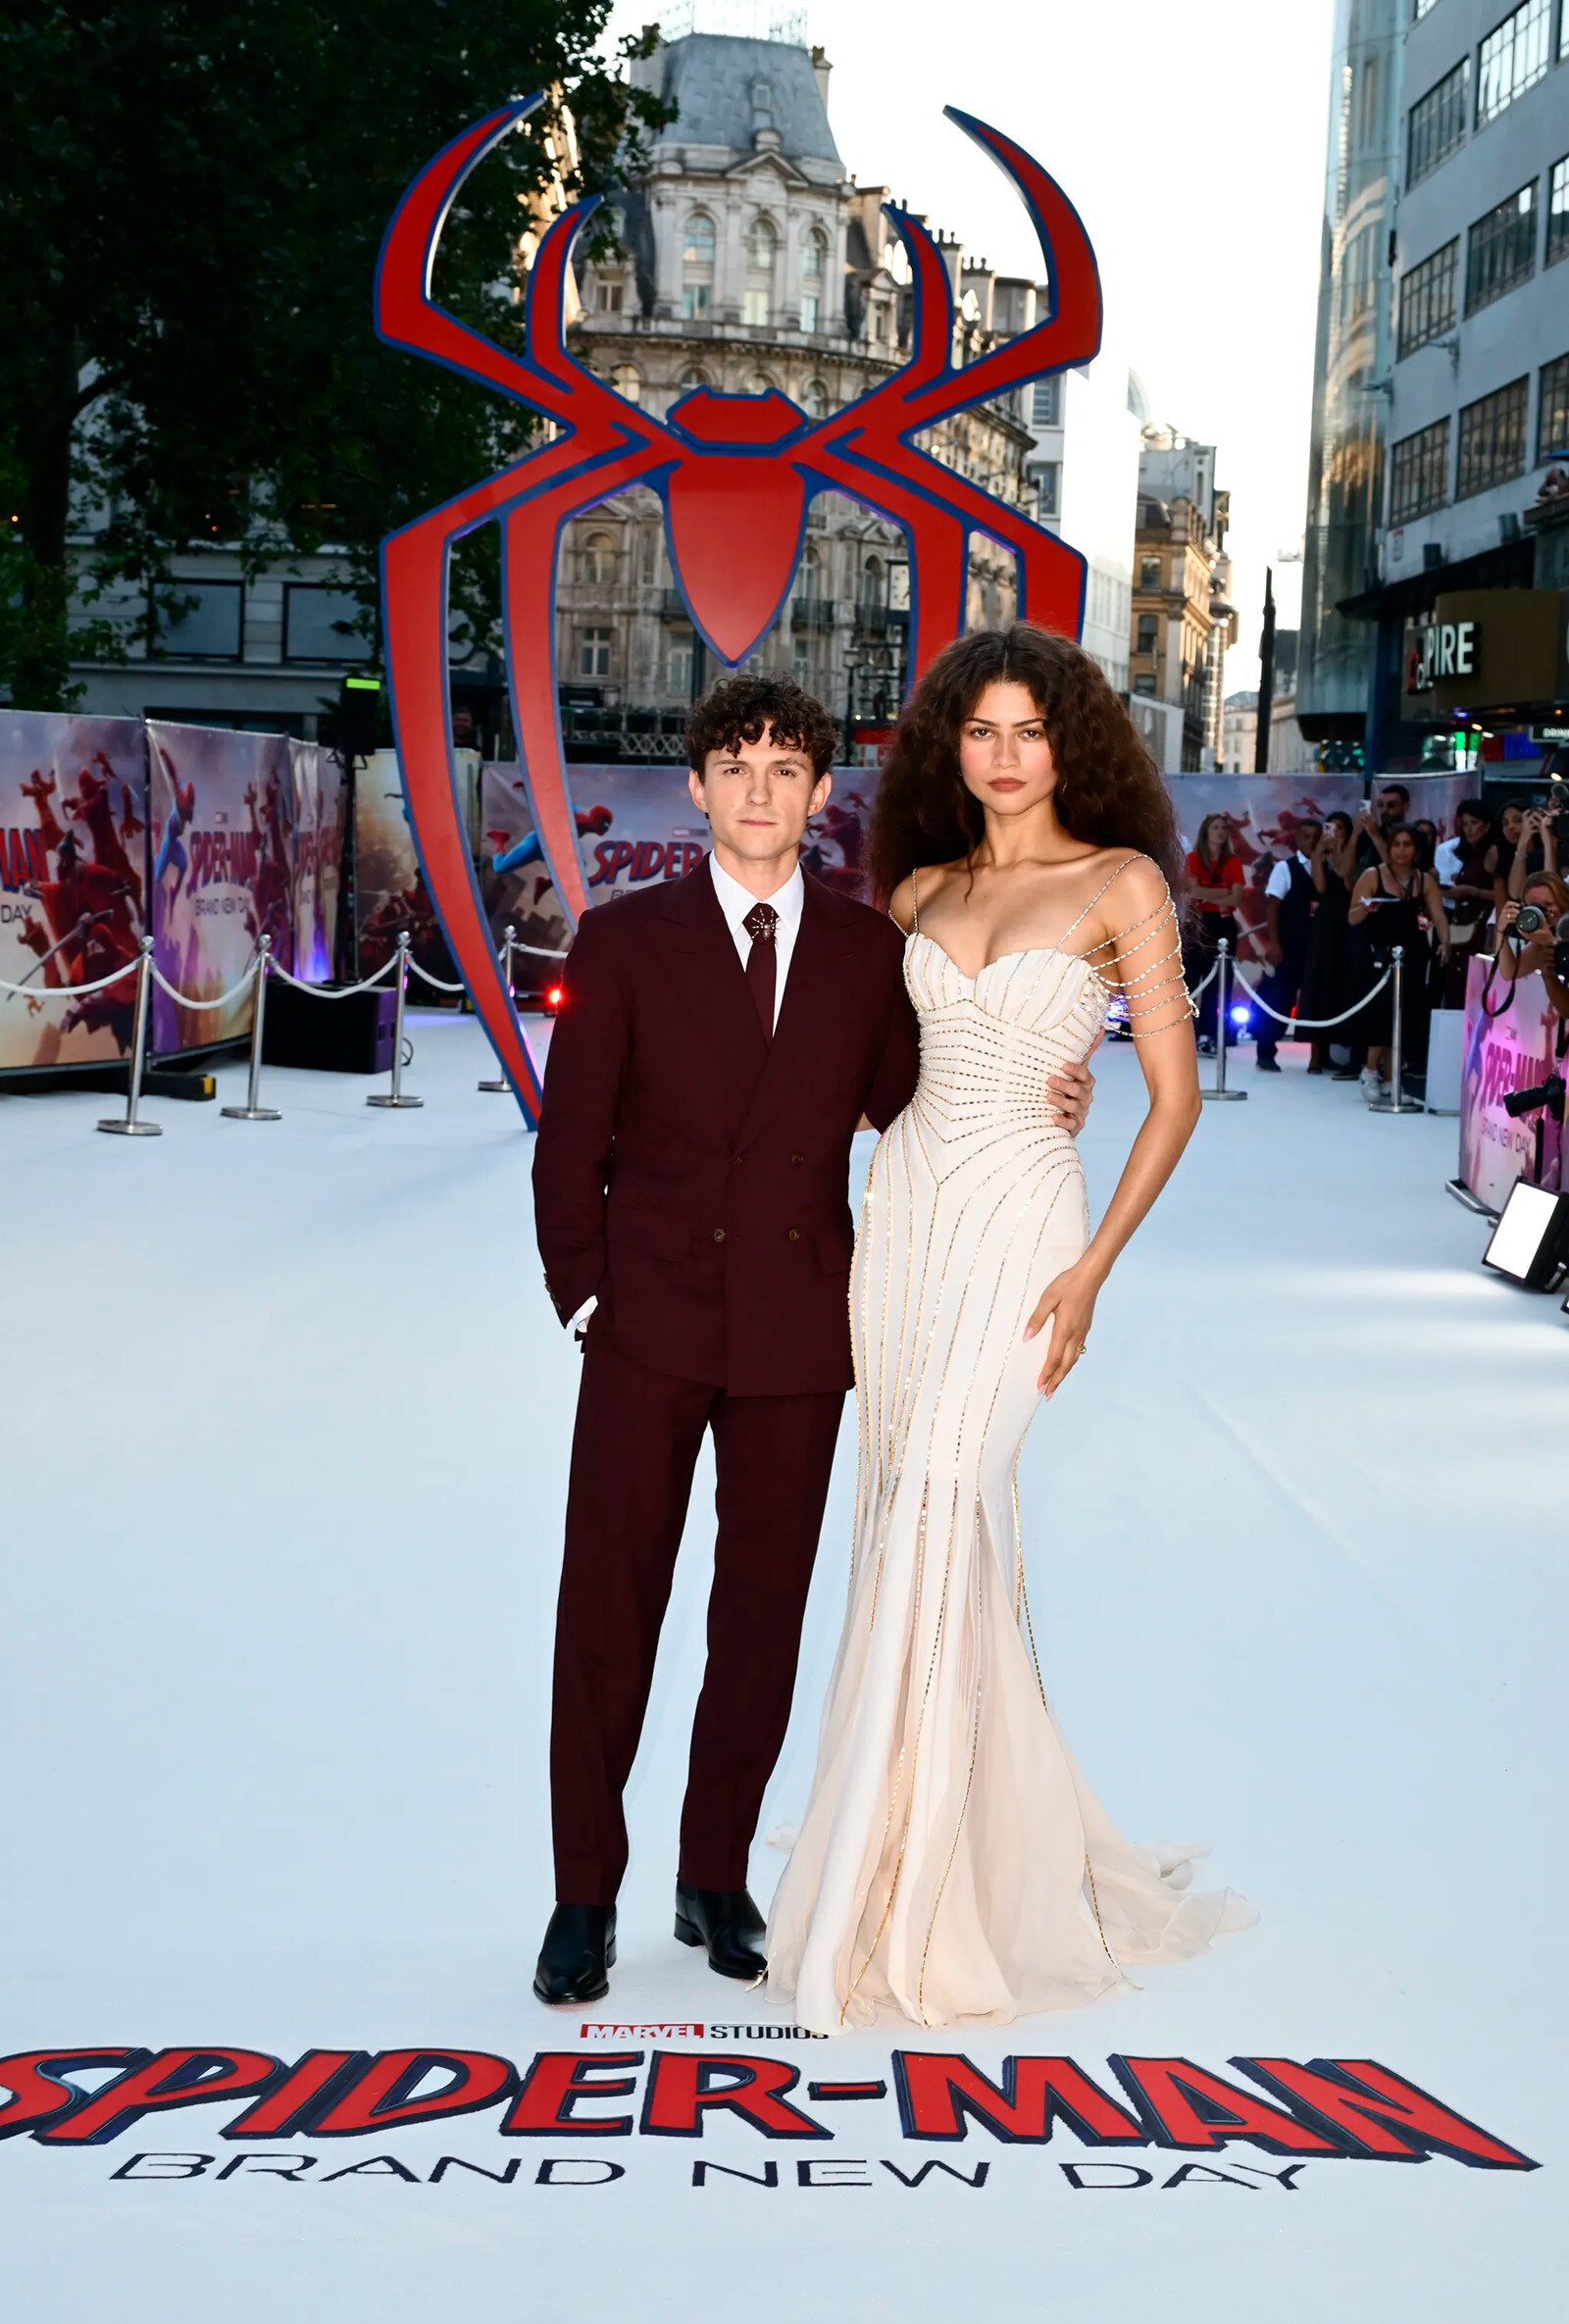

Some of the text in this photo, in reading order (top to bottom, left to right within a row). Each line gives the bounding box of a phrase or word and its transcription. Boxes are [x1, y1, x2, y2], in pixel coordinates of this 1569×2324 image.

[1, 904, 32, 923] DAY
[582, 2024, 704, 2039] MARVEL
[0, 2046, 1544, 2172] SPIDER-MAN
[109, 2153, 1307, 2191] BRAND NEW DAY
